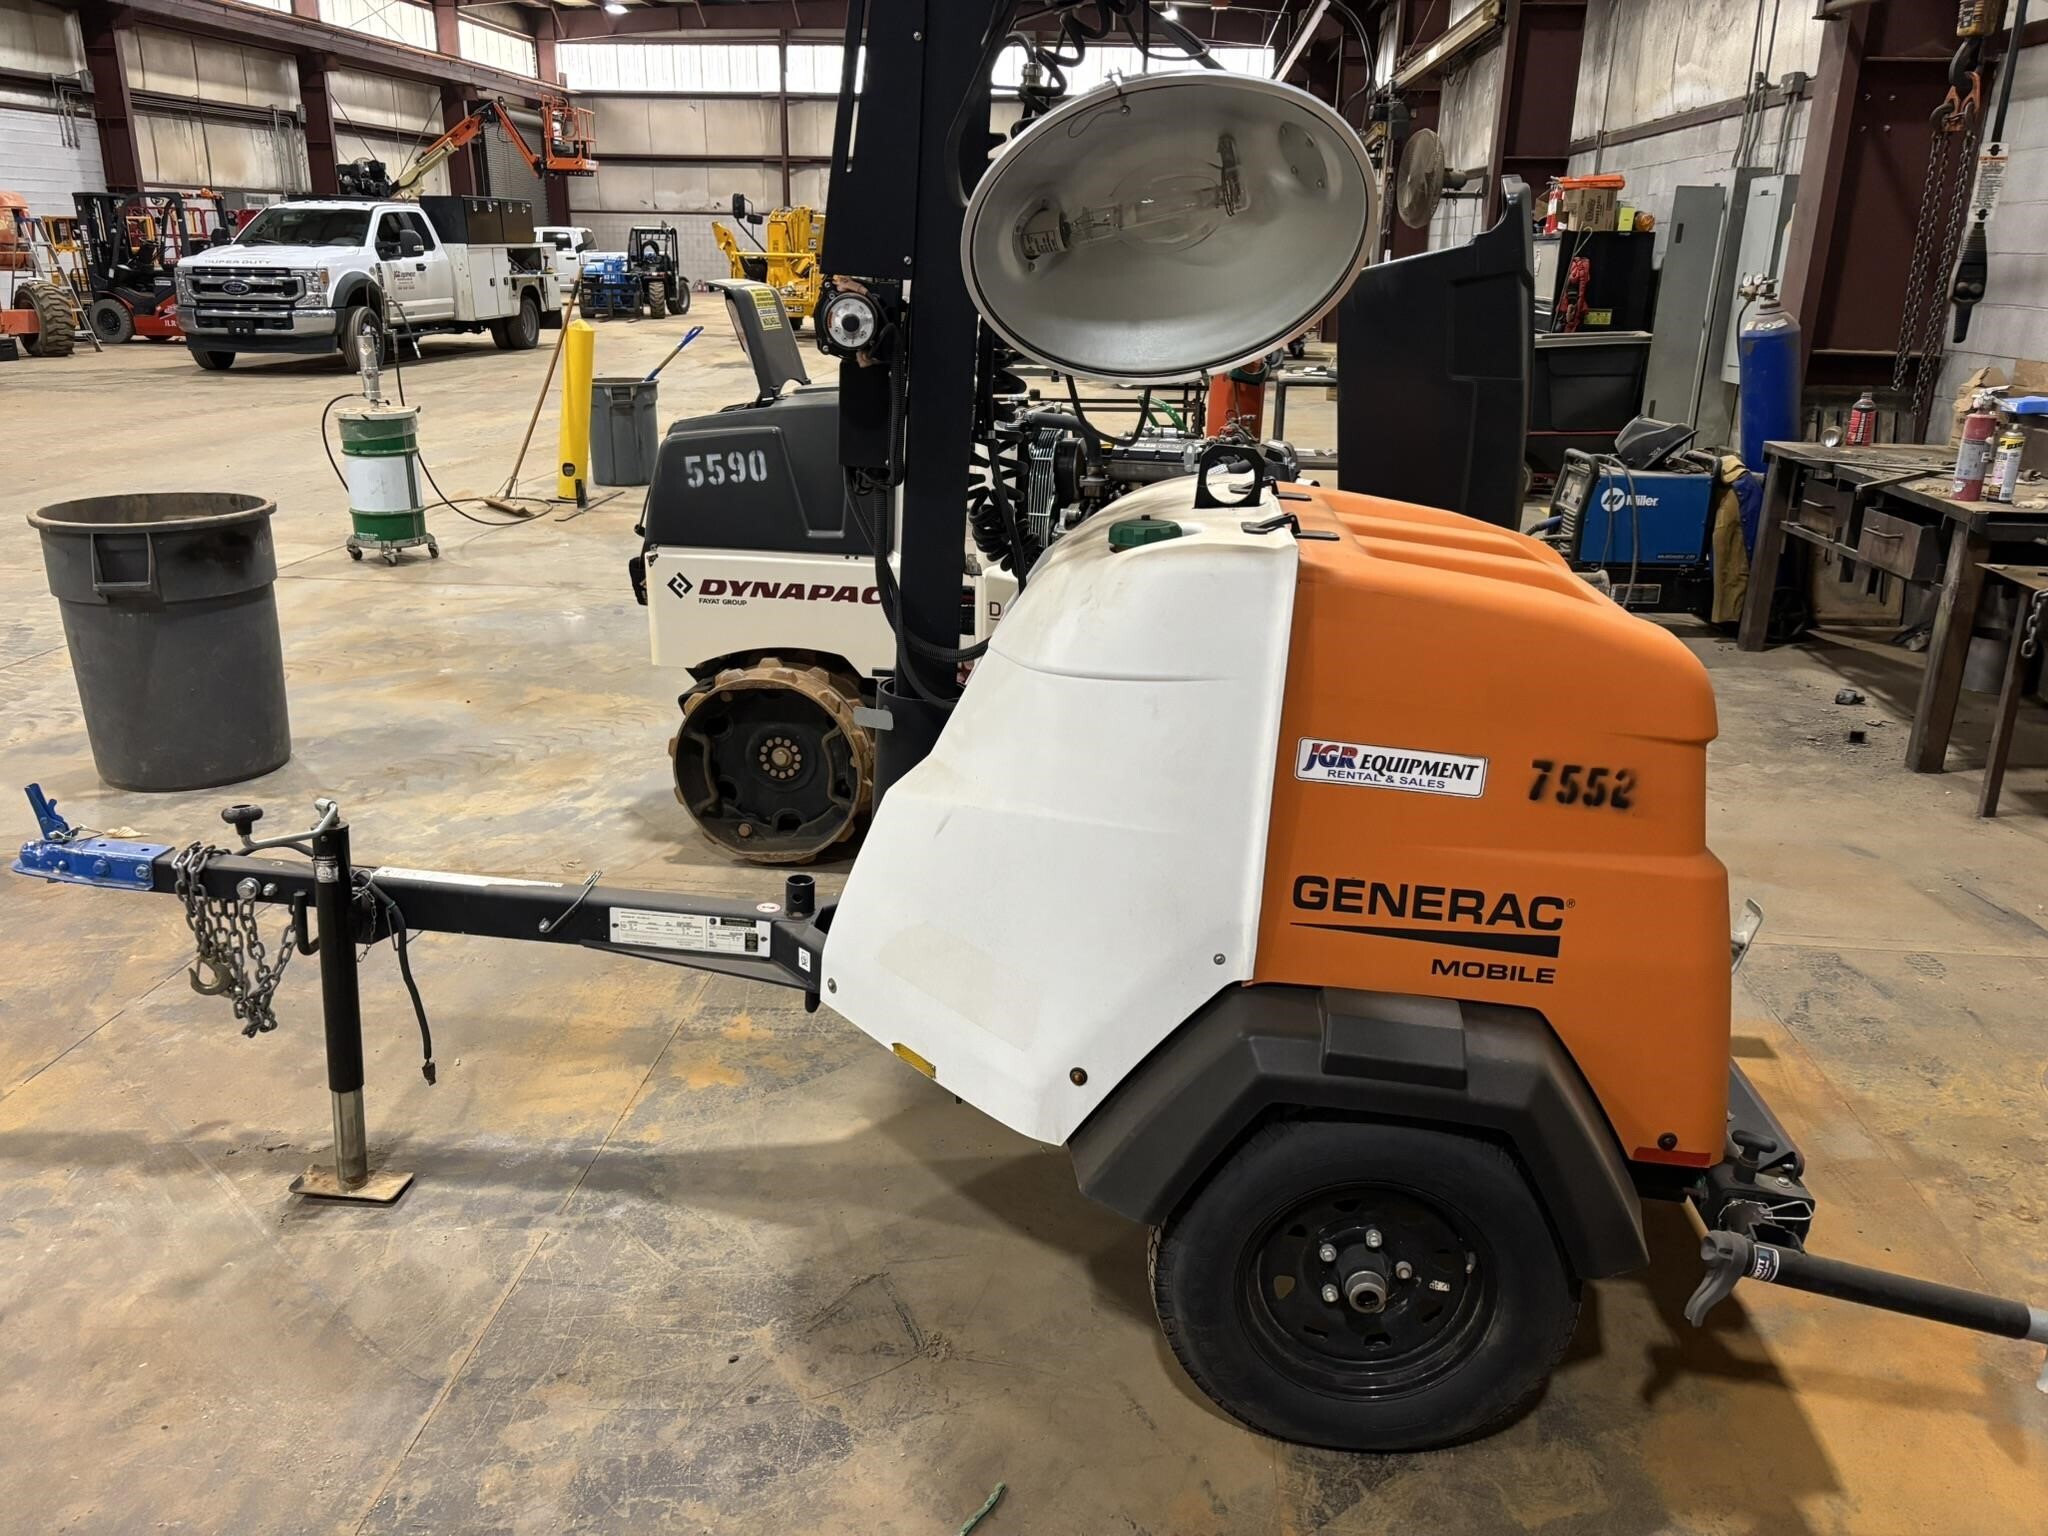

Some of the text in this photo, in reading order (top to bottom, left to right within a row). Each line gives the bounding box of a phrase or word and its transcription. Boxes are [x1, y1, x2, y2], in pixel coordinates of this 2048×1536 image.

[685, 449, 768, 488] 5590
[1626, 495, 1659, 506] Miller
[1303, 743, 1479, 781] JGR EQUIPMENT
[1327, 769, 1446, 789] RENTAL & SALES
[1529, 759, 1636, 809] 7552
[1293, 875, 1565, 930] GENERAC
[1431, 959, 1556, 984] MOBILE
